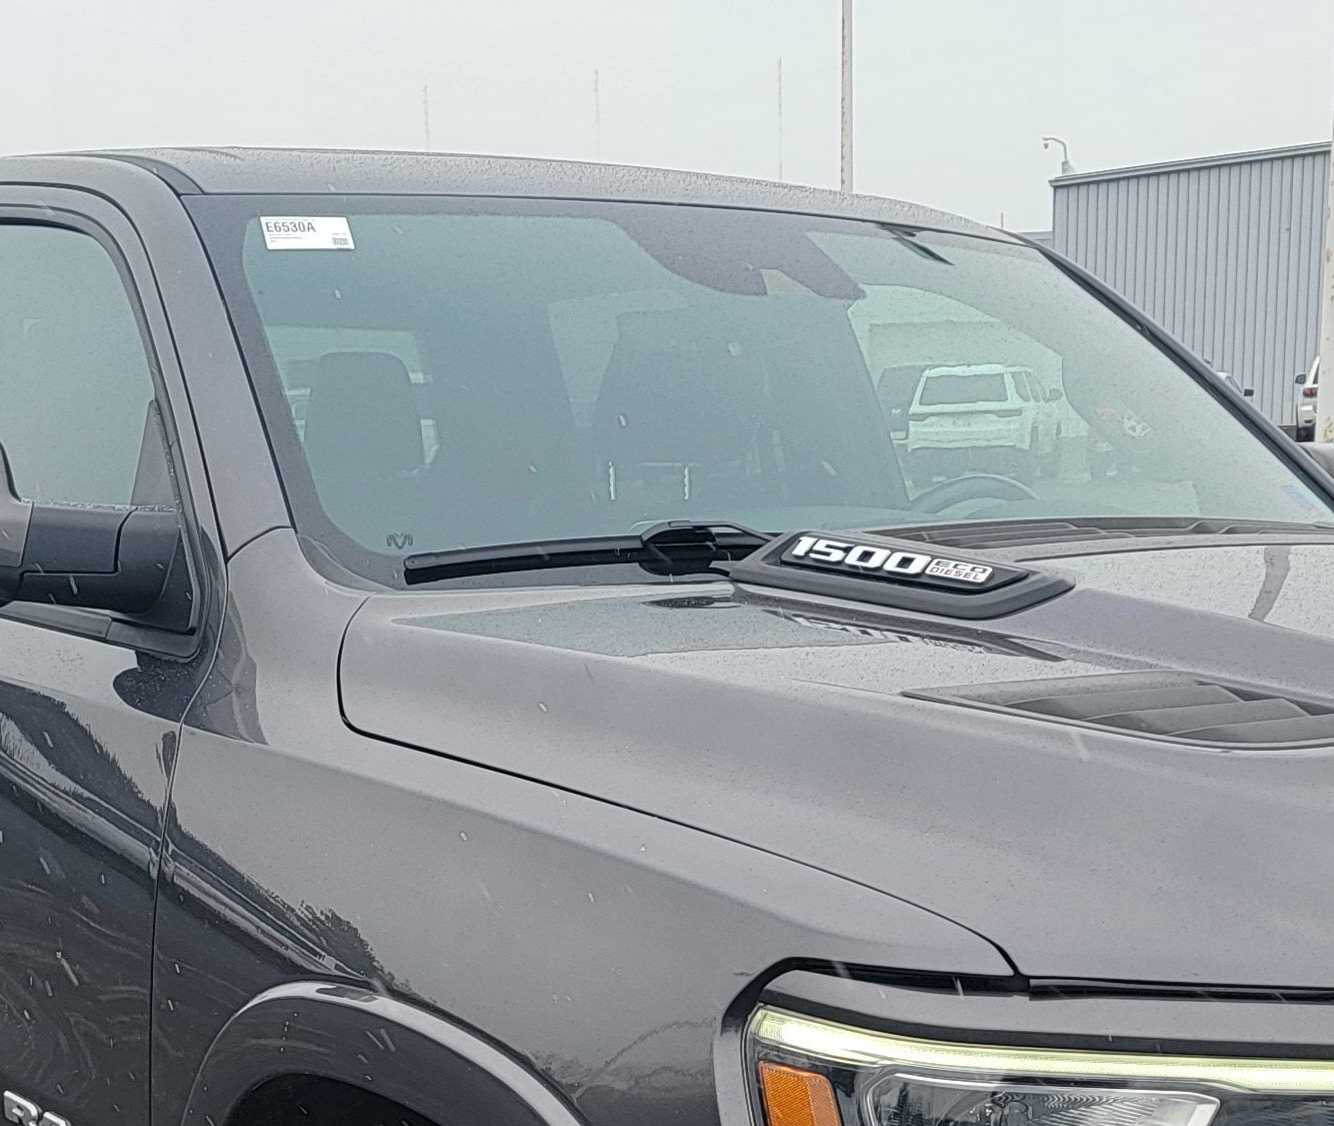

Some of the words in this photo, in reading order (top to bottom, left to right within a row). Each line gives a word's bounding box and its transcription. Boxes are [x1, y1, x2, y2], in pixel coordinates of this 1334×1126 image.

[265, 221, 316, 233] E6530A
[791, 536, 932, 575] 1500
[929, 566, 981, 581] DIESEL
[936, 560, 988, 573] ECO
